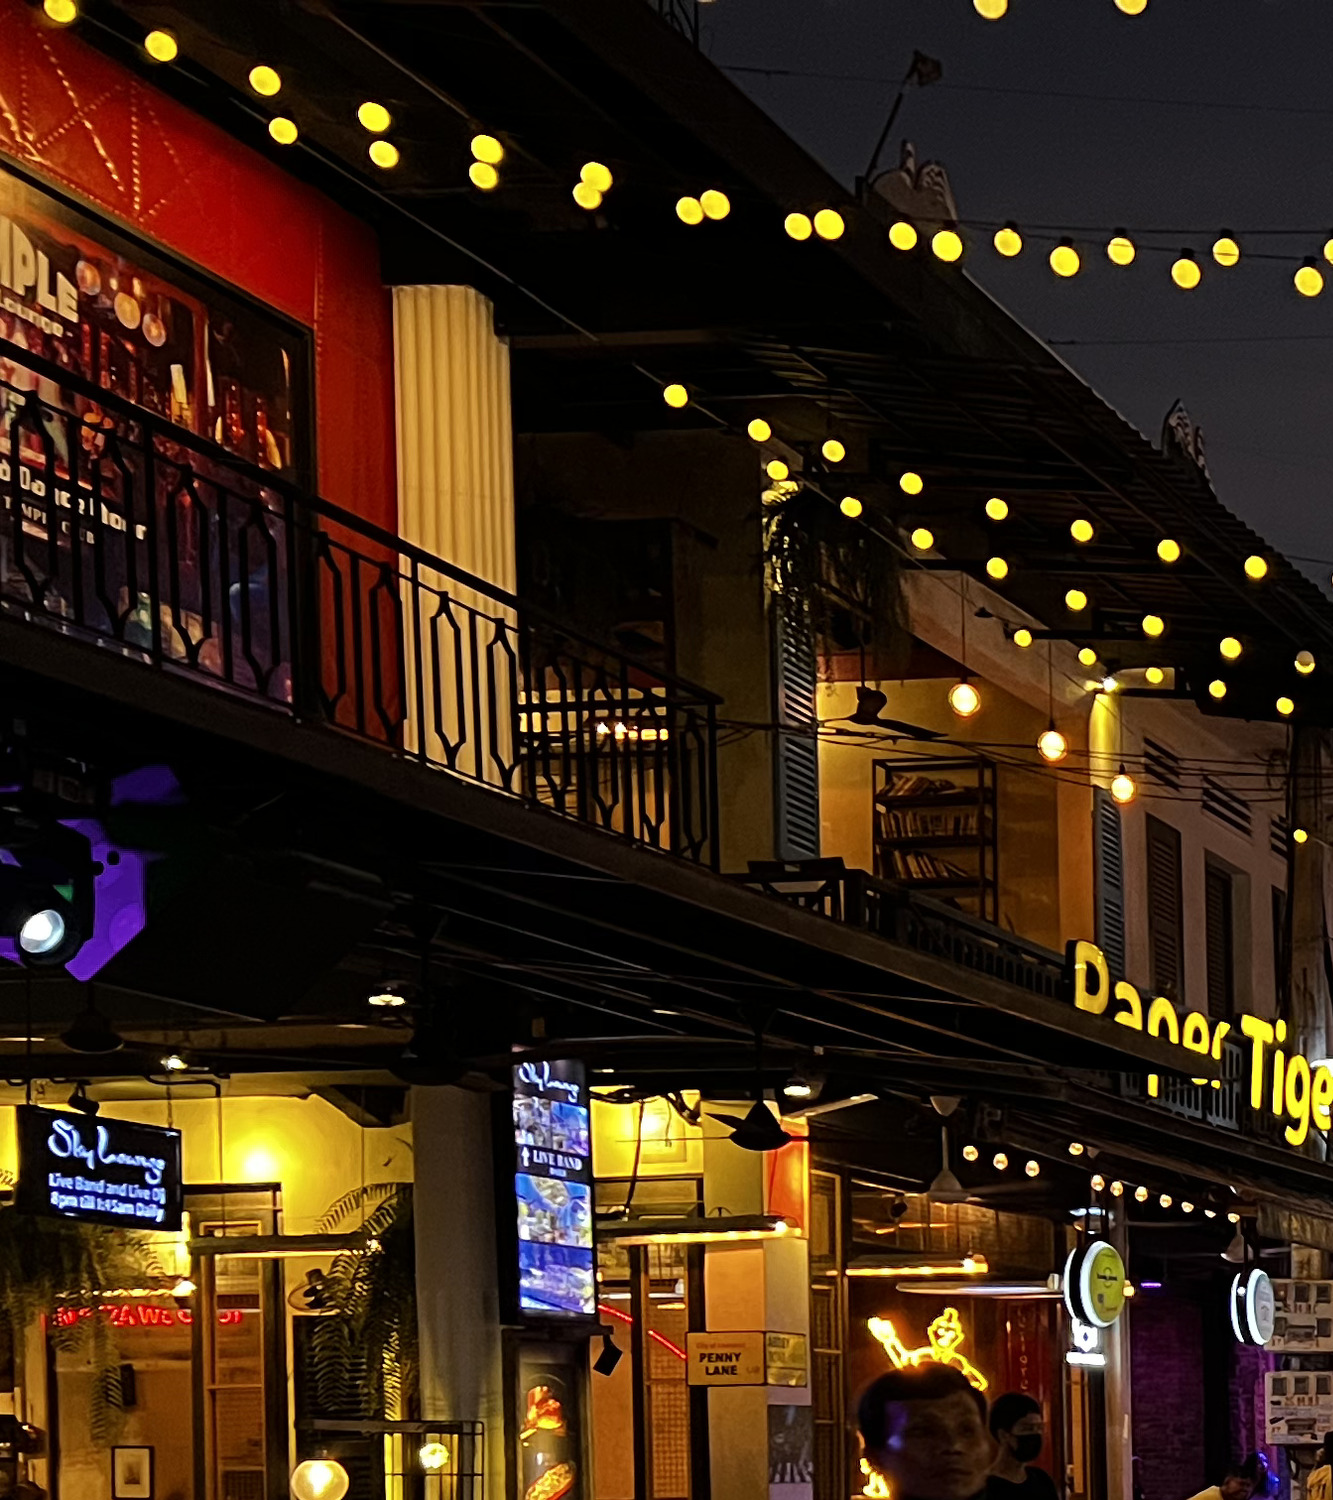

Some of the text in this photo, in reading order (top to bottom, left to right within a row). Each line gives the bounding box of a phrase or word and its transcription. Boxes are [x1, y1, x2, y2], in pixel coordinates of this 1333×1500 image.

[48, 1172, 74, 1190] Live
[75, 1176, 105, 1194] Band
[106, 1182, 127, 1197] and
[128, 1183, 150, 1201] Live
[50, 1190, 78, 1210] 8pm
[135, 1201, 166, 1223] Daily
[698, 1352, 742, 1363] PENNY
[705, 1365, 738, 1376] LANE
